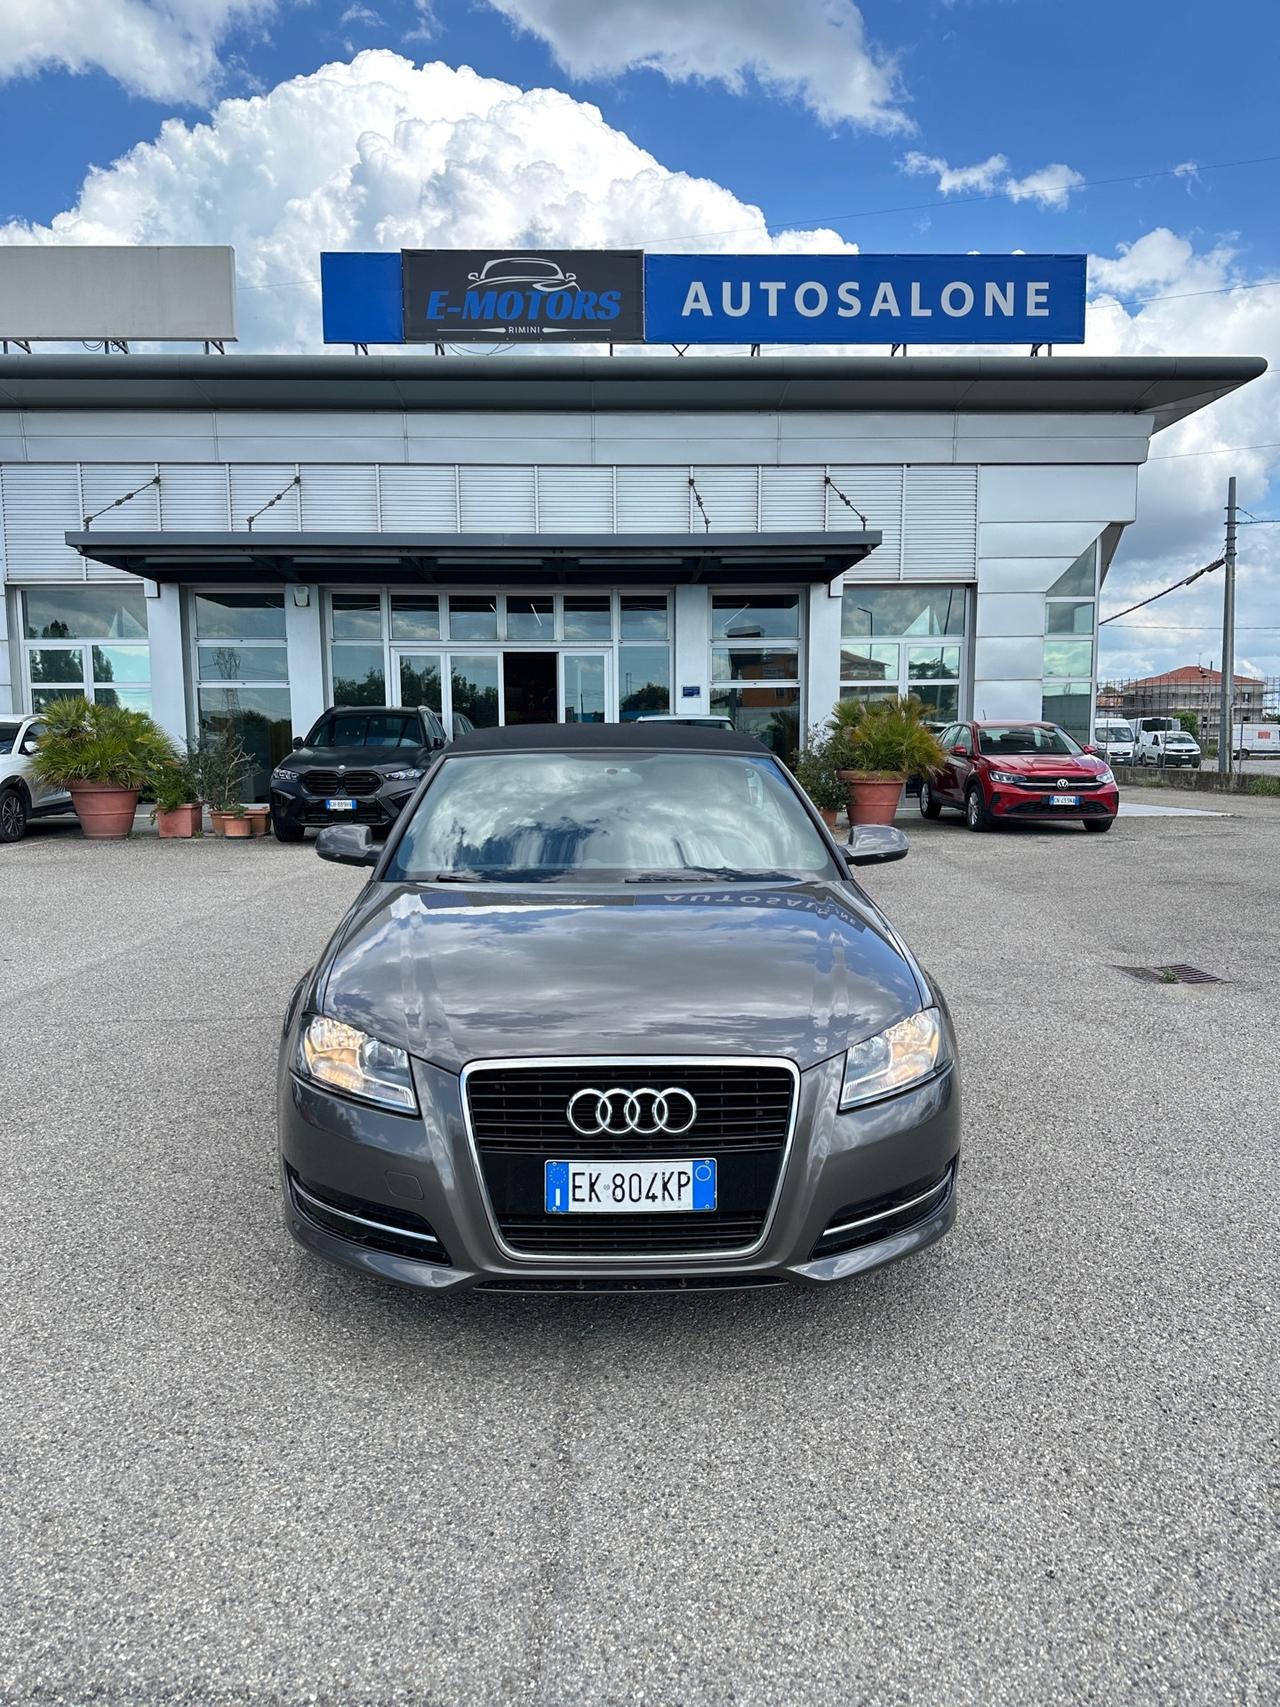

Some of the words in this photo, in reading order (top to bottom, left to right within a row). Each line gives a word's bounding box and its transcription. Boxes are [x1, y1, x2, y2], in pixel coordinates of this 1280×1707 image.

[426, 290, 622, 321] E-MOTORS
[681, 281, 1050, 317] AUTOSALONE
[508, 326, 541, 334] RIMINI
[571, 1172, 602, 1203] EK
[612, 1171, 691, 1203] 804KP
